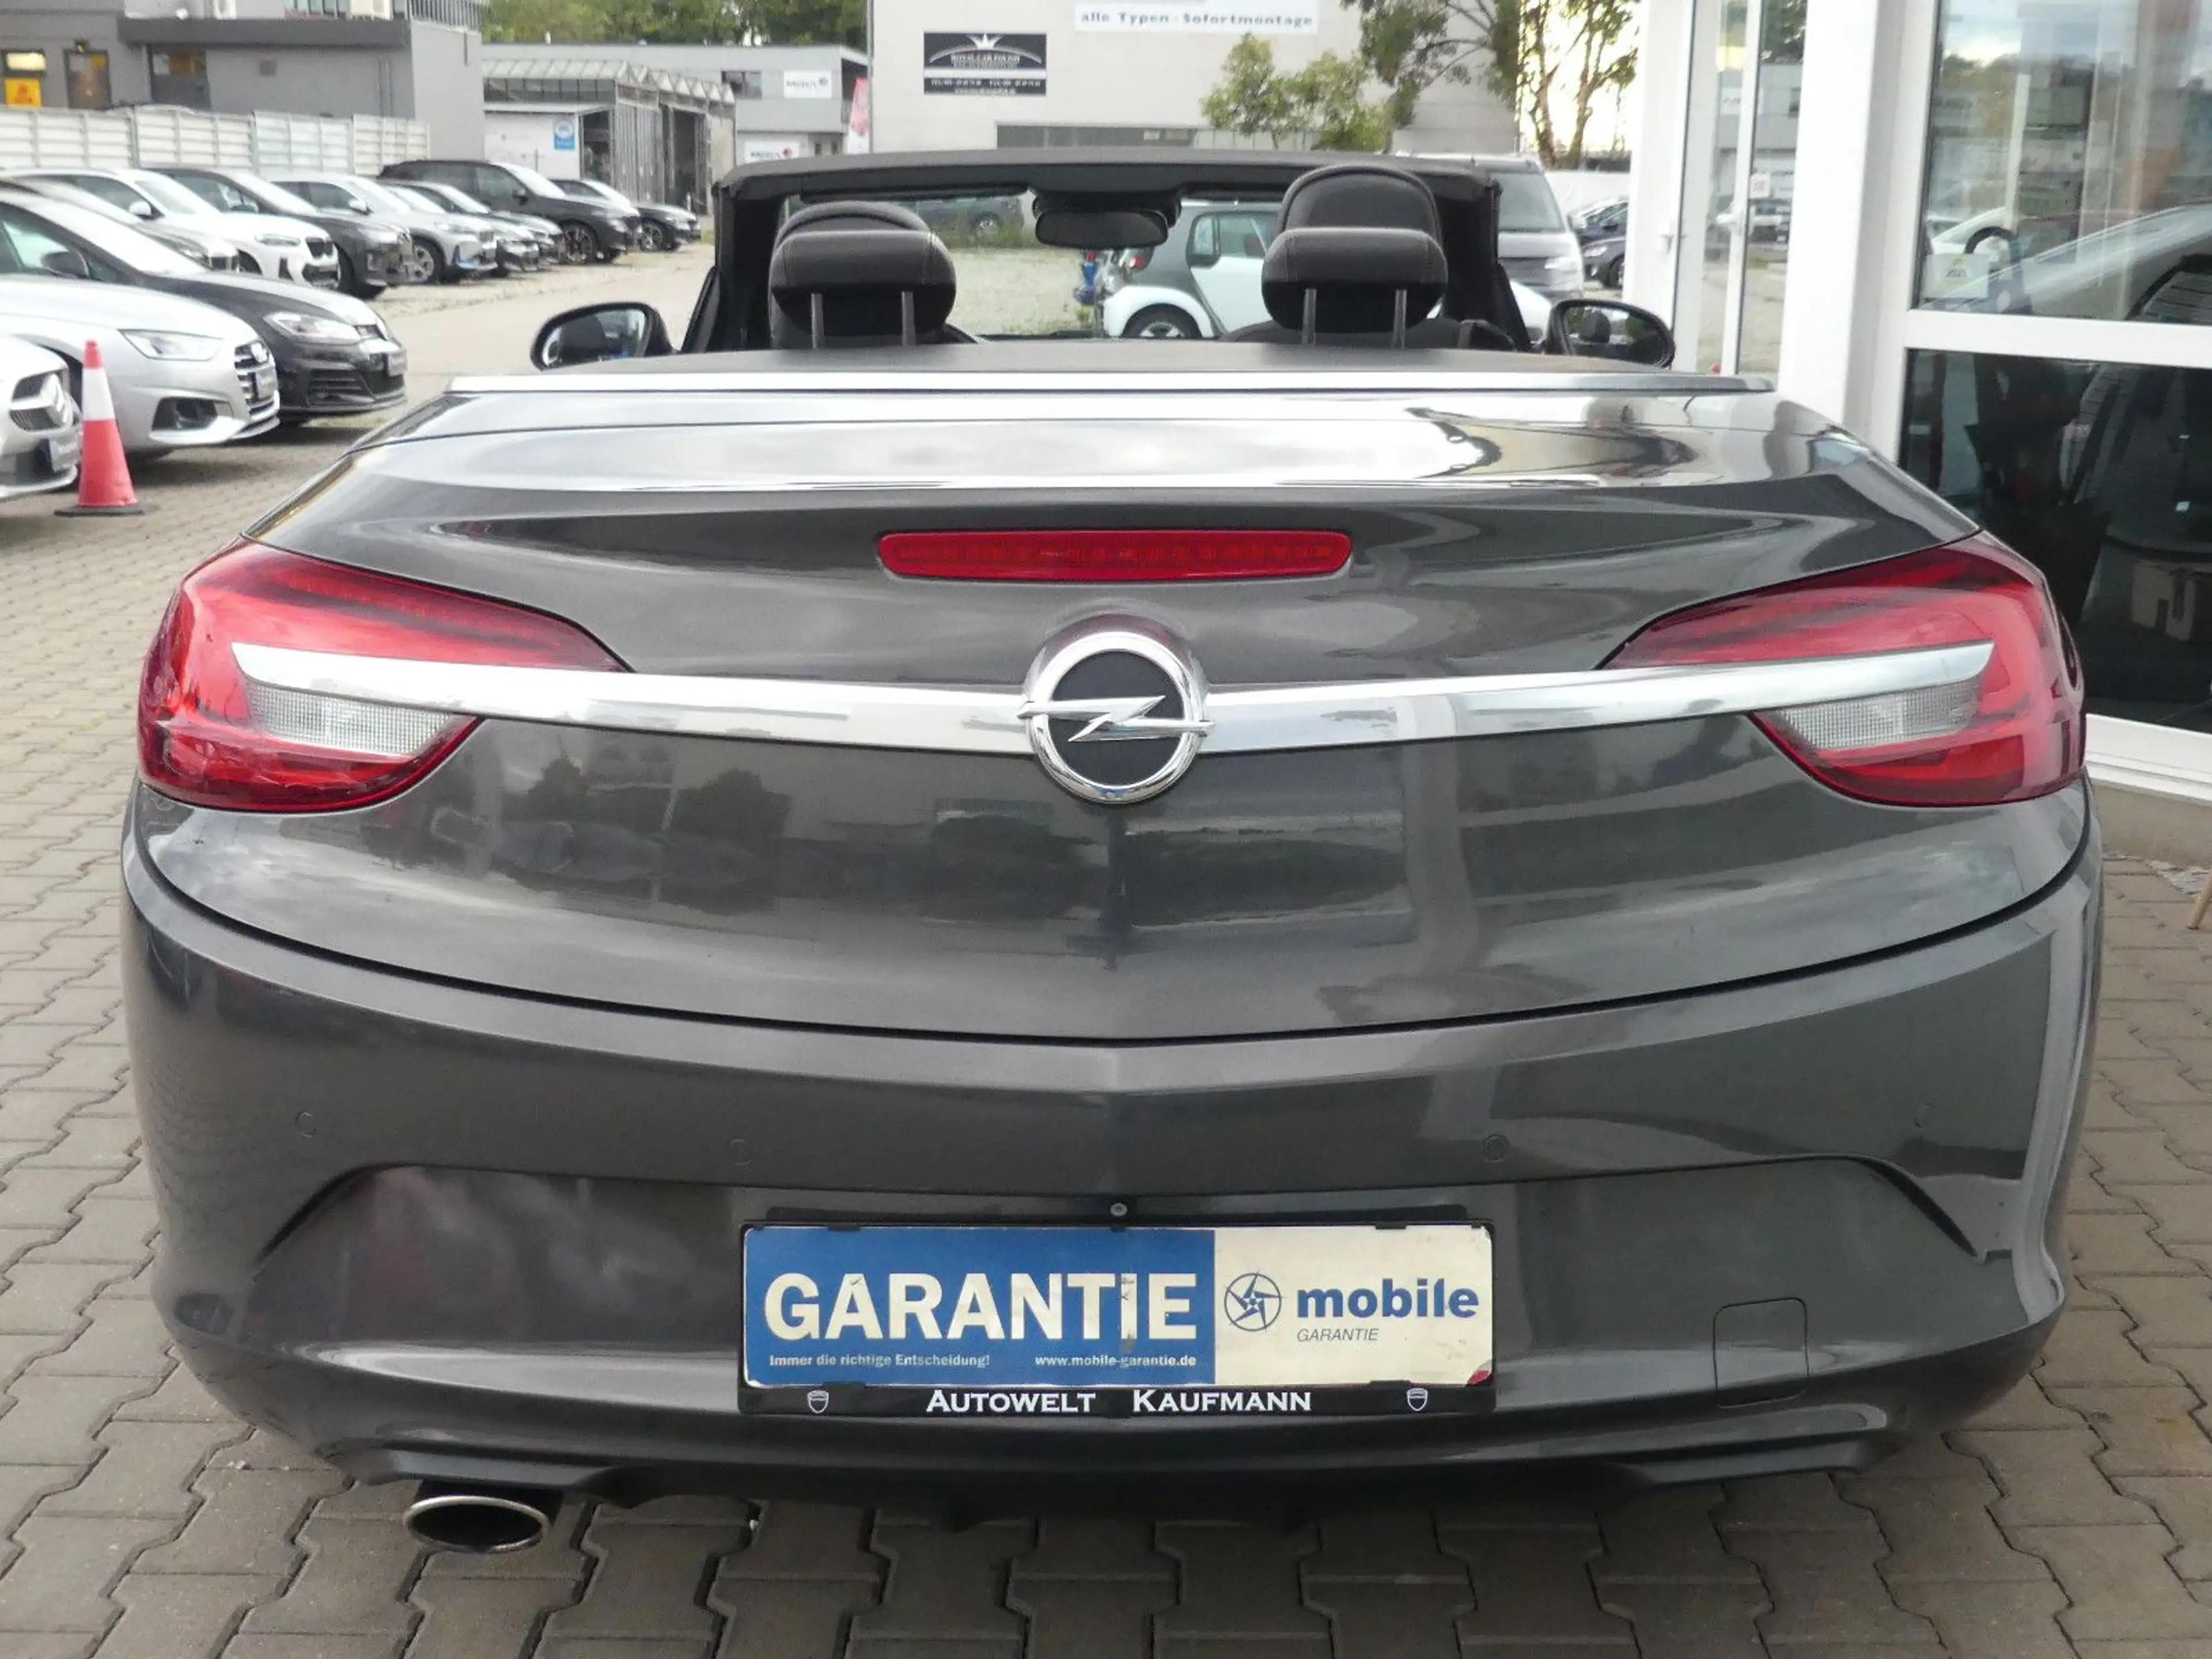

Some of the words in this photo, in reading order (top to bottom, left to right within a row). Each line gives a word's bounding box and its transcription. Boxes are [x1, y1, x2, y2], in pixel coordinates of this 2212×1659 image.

[1119, 12, 1169, 26] Typen
[1183, 13, 1313, 28] Sofortmontage
[764, 1272, 1197, 1340] GARANTIE
[1297, 1278, 1479, 1319] mobile
[1297, 1328, 1380, 1342] GARANTIE
[770, 1355, 813, 1366] Immer
[816, 1354, 836, 1366] die
[840, 1354, 892, 1368] richtige
[895, 1354, 990, 1368] Entscheidung!
[1035, 1354, 1197, 1368] www.mobile-garantie.de
